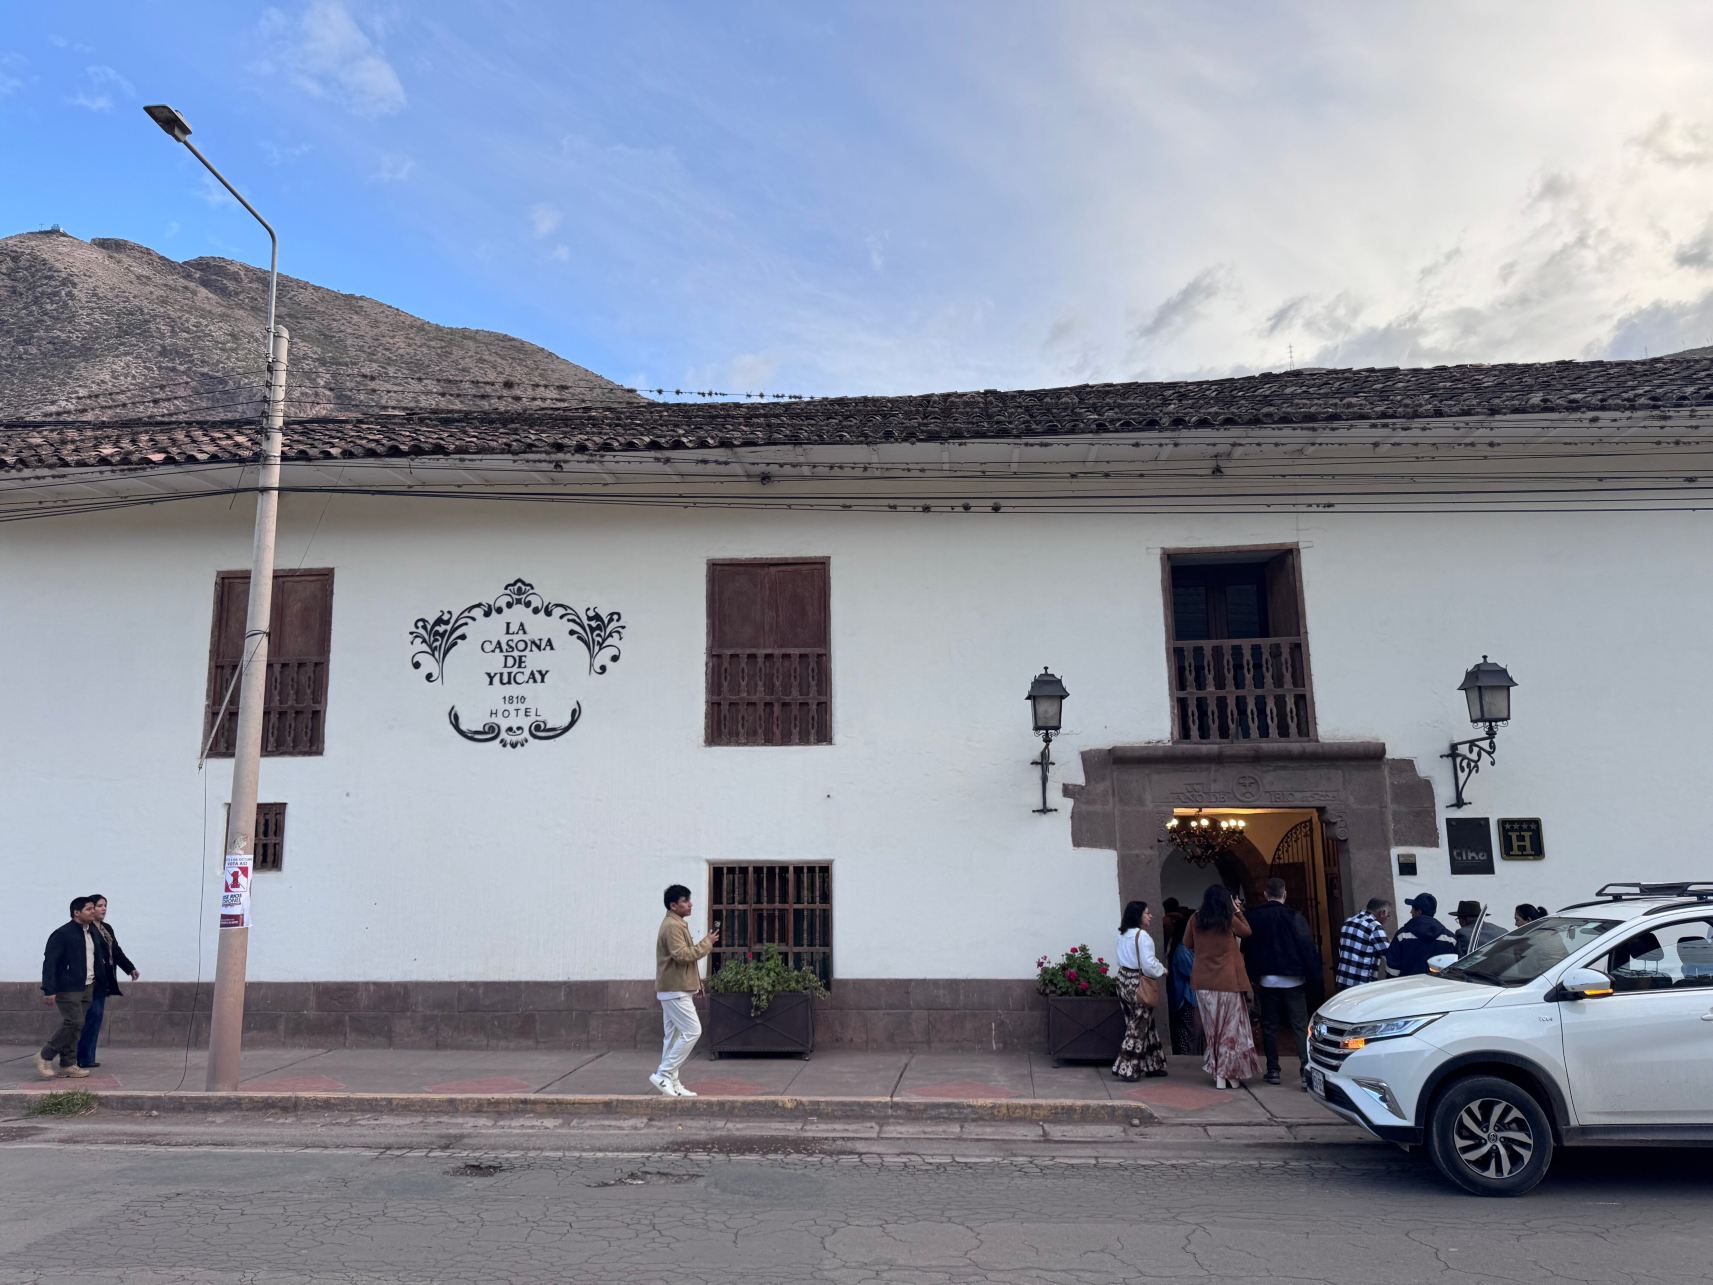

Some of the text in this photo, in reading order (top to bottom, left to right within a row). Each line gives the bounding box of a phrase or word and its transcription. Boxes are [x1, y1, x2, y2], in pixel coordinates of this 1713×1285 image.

[505, 622, 528, 635] LA
[481, 638, 556, 653] CASONA
[503, 655, 527, 669] DE
[485, 670, 550, 686] YUCAY
[502, 695, 527, 705] 1810
[490, 708, 542, 719] HOTEL
[1508, 831, 1535, 855] H
[230, 870, 240, 888] 1
